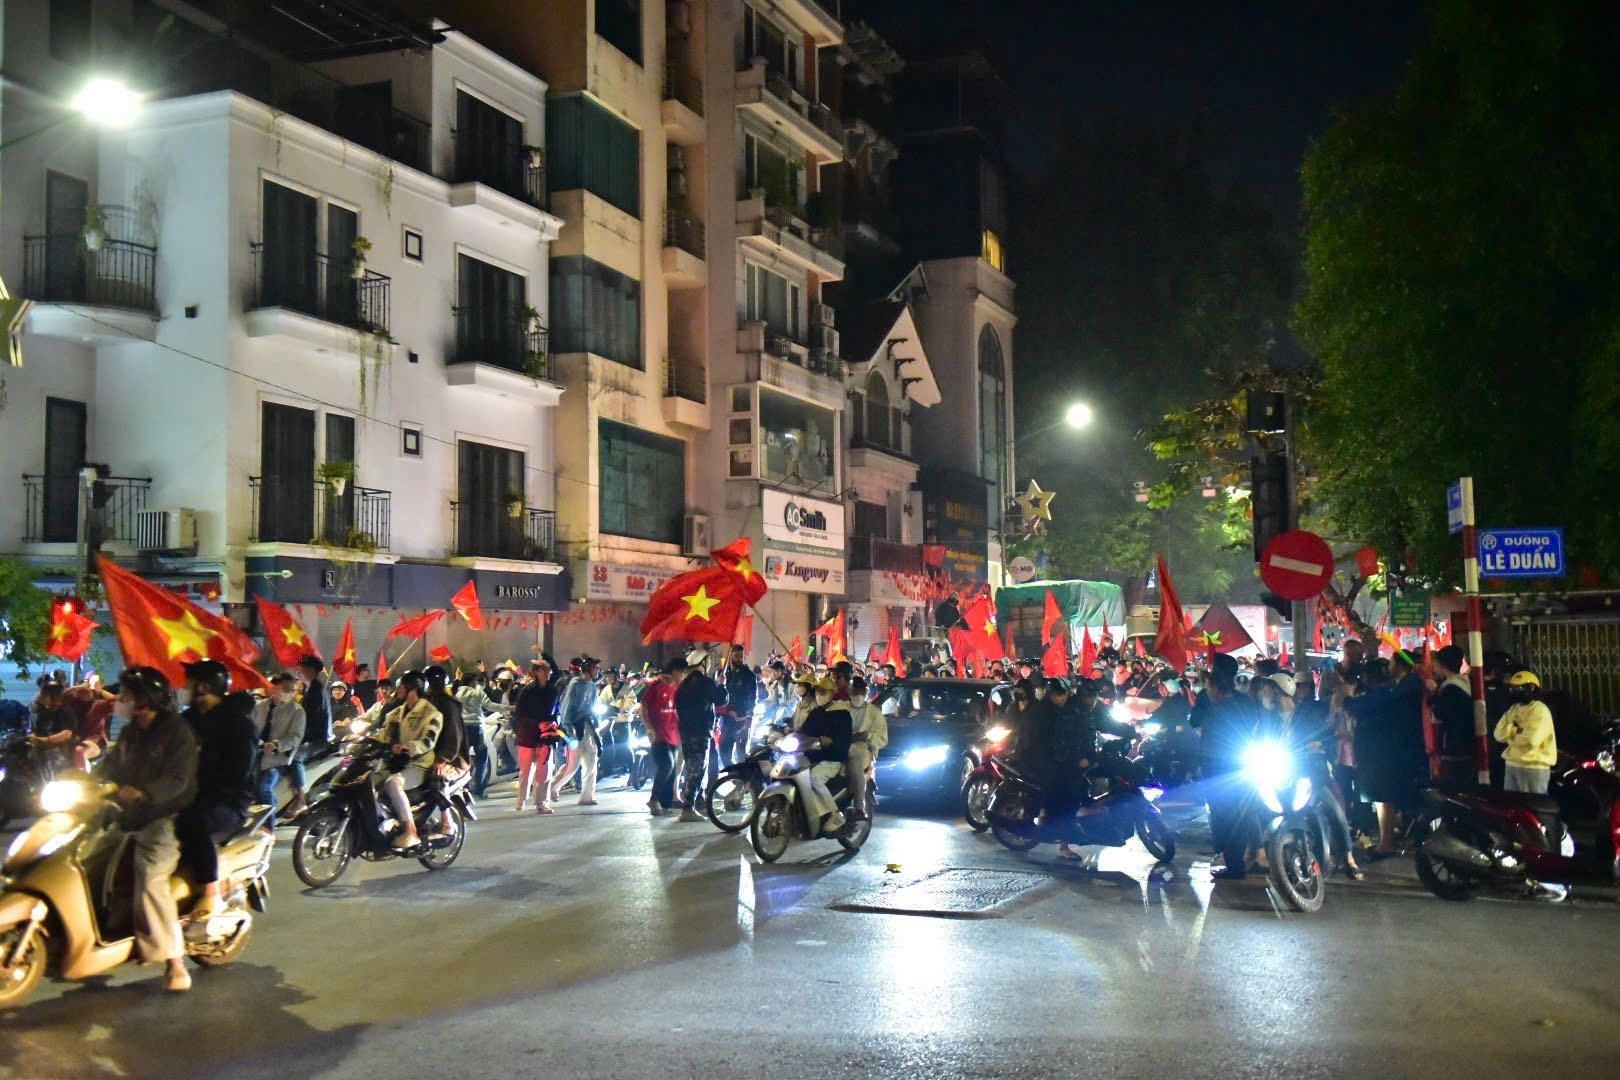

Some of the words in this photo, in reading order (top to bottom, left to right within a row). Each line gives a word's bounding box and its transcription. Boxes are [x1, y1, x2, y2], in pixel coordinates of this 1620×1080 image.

[1504, 535, 1550, 546] ĐƯỜNG
[1485, 550, 1506, 570] LÊ
[1510, 546, 1556, 570] DUẨN
[499, 585, 537, 599] BAROSSI
